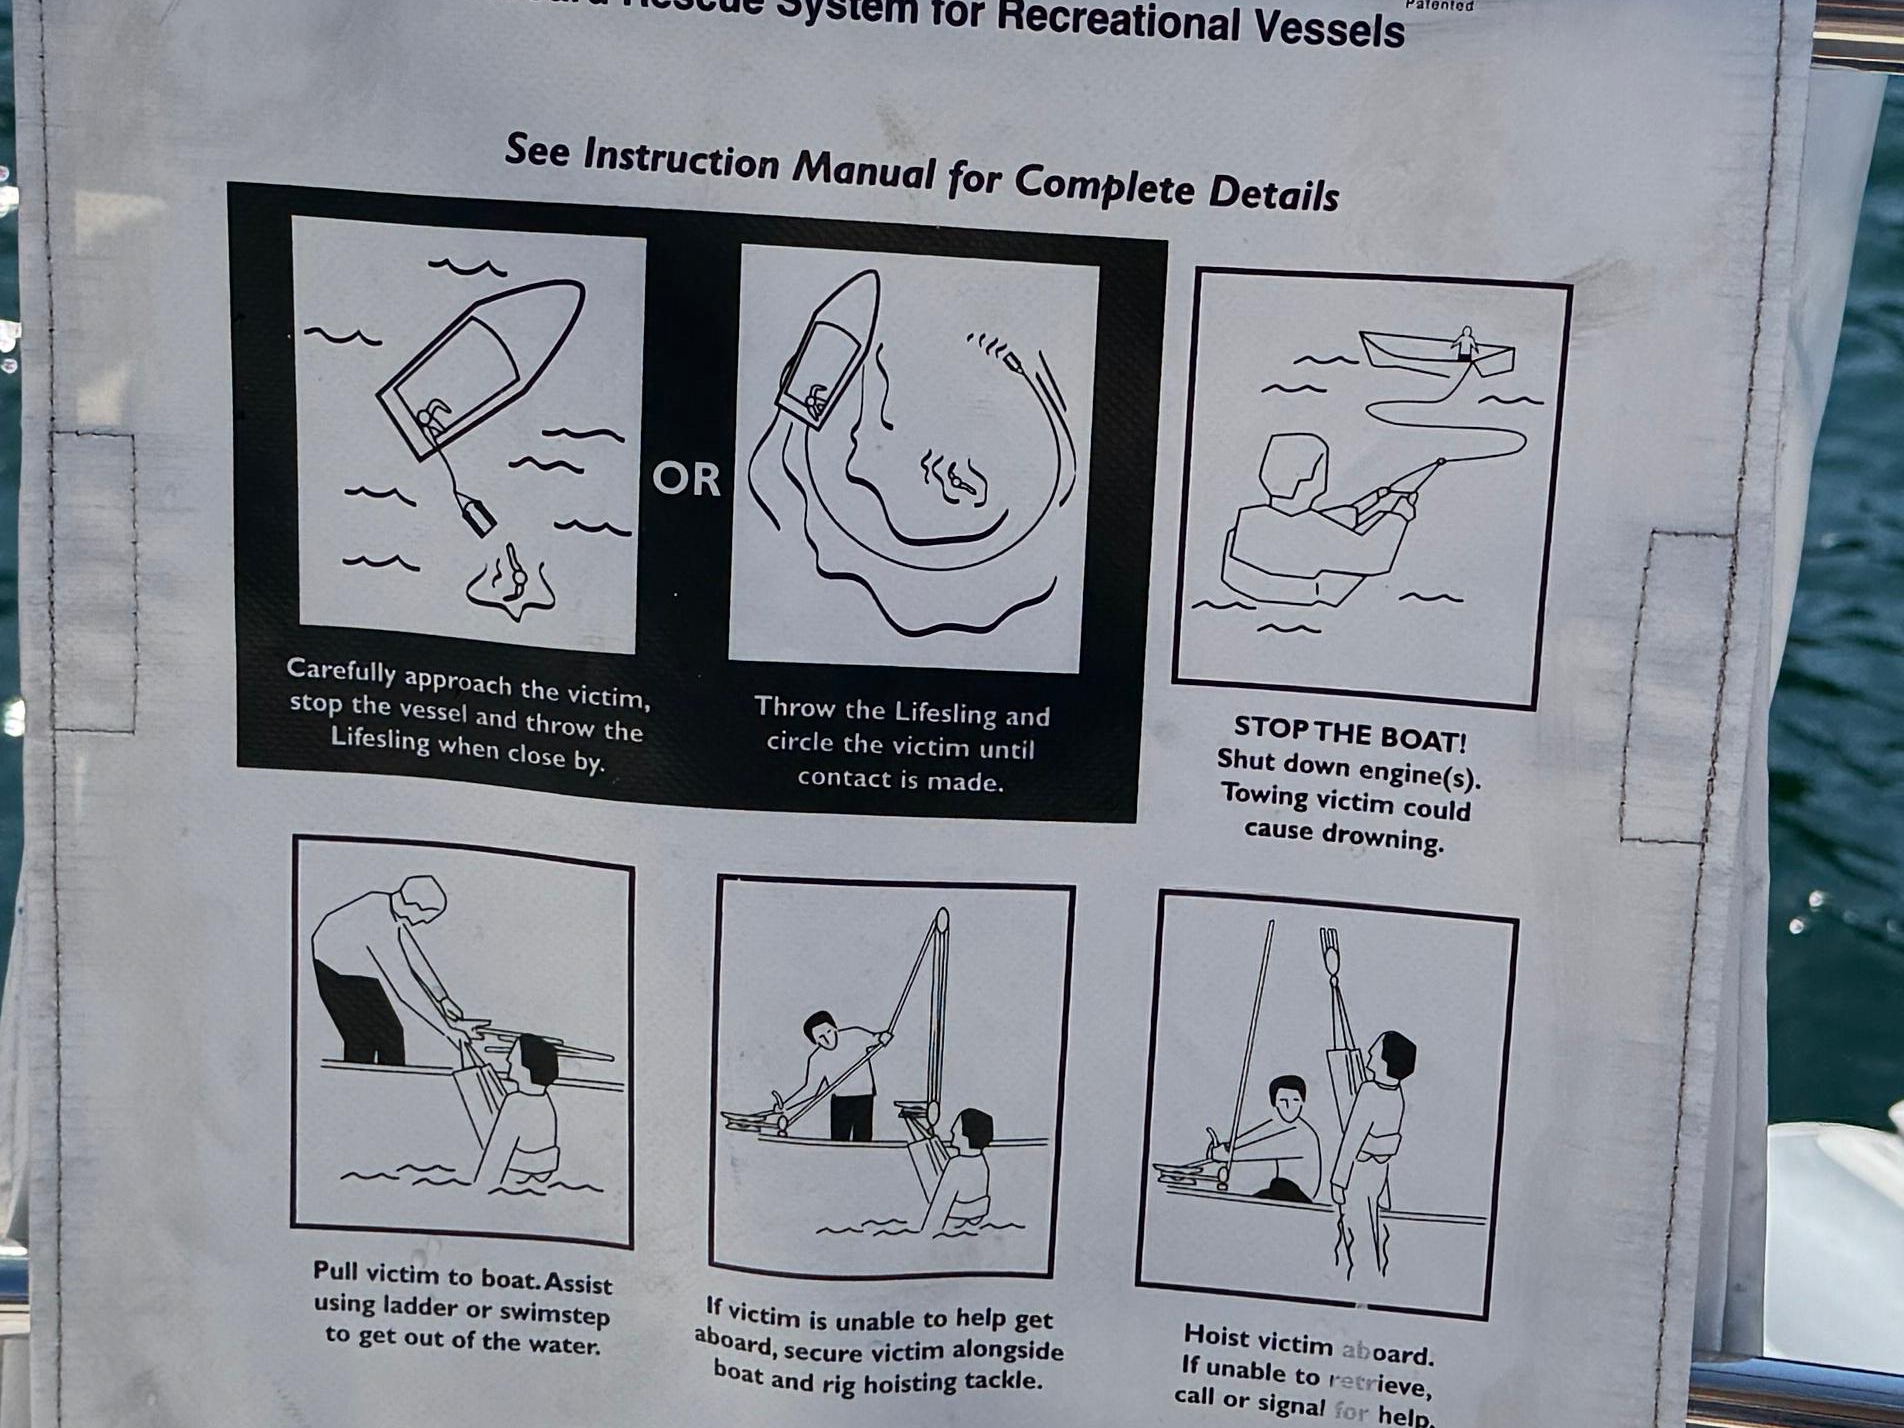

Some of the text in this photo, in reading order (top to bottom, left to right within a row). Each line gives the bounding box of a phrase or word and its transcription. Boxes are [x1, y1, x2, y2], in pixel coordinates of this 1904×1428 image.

[1255, 9, 1405, 48] Vessels
[505, 131, 1339, 211] See Instruction Manual for Complete Details
[653, 461, 720, 496] OR
[287, 657, 650, 712] Carefully approach the victim,
[291, 695, 643, 742] stop the vessel and throw the
[755, 695, 1049, 730] Throw the Lifesling and
[332, 726, 604, 776] Lifesling when close by.
[768, 730, 1034, 759] circle the victim until
[1235, 716, 1466, 754] STOP THE BOAT!
[799, 770, 1003, 792] contact is made.
[1218, 748, 1481, 794] Shut down engine(s).
[1221, 781, 1471, 821] Towing victim could
[1245, 822, 1444, 858] cause drowning.
[314, 1260, 612, 1295] Pull victim to boat. Assist
[315, 1293, 610, 1331] using ladder or swimstep
[707, 1295, 1053, 1333] If victim is unable to help get
[326, 1327, 600, 1355] to get out of the water.
[695, 1326, 1064, 1363] aboard, secure victim alongside
[1185, 1323, 1434, 1367] Hoist victim aboard.
[715, 1357, 1042, 1399] boat and rig hoisting tackle.
[1183, 1354, 1432, 1402] If unable to retrieve,
[1175, 1387, 1214, 1405] call
[1224, 1395, 1250, 1408] or
[1259, 1394, 1325, 1418] signal
[1335, 1401, 1369, 1422] for
